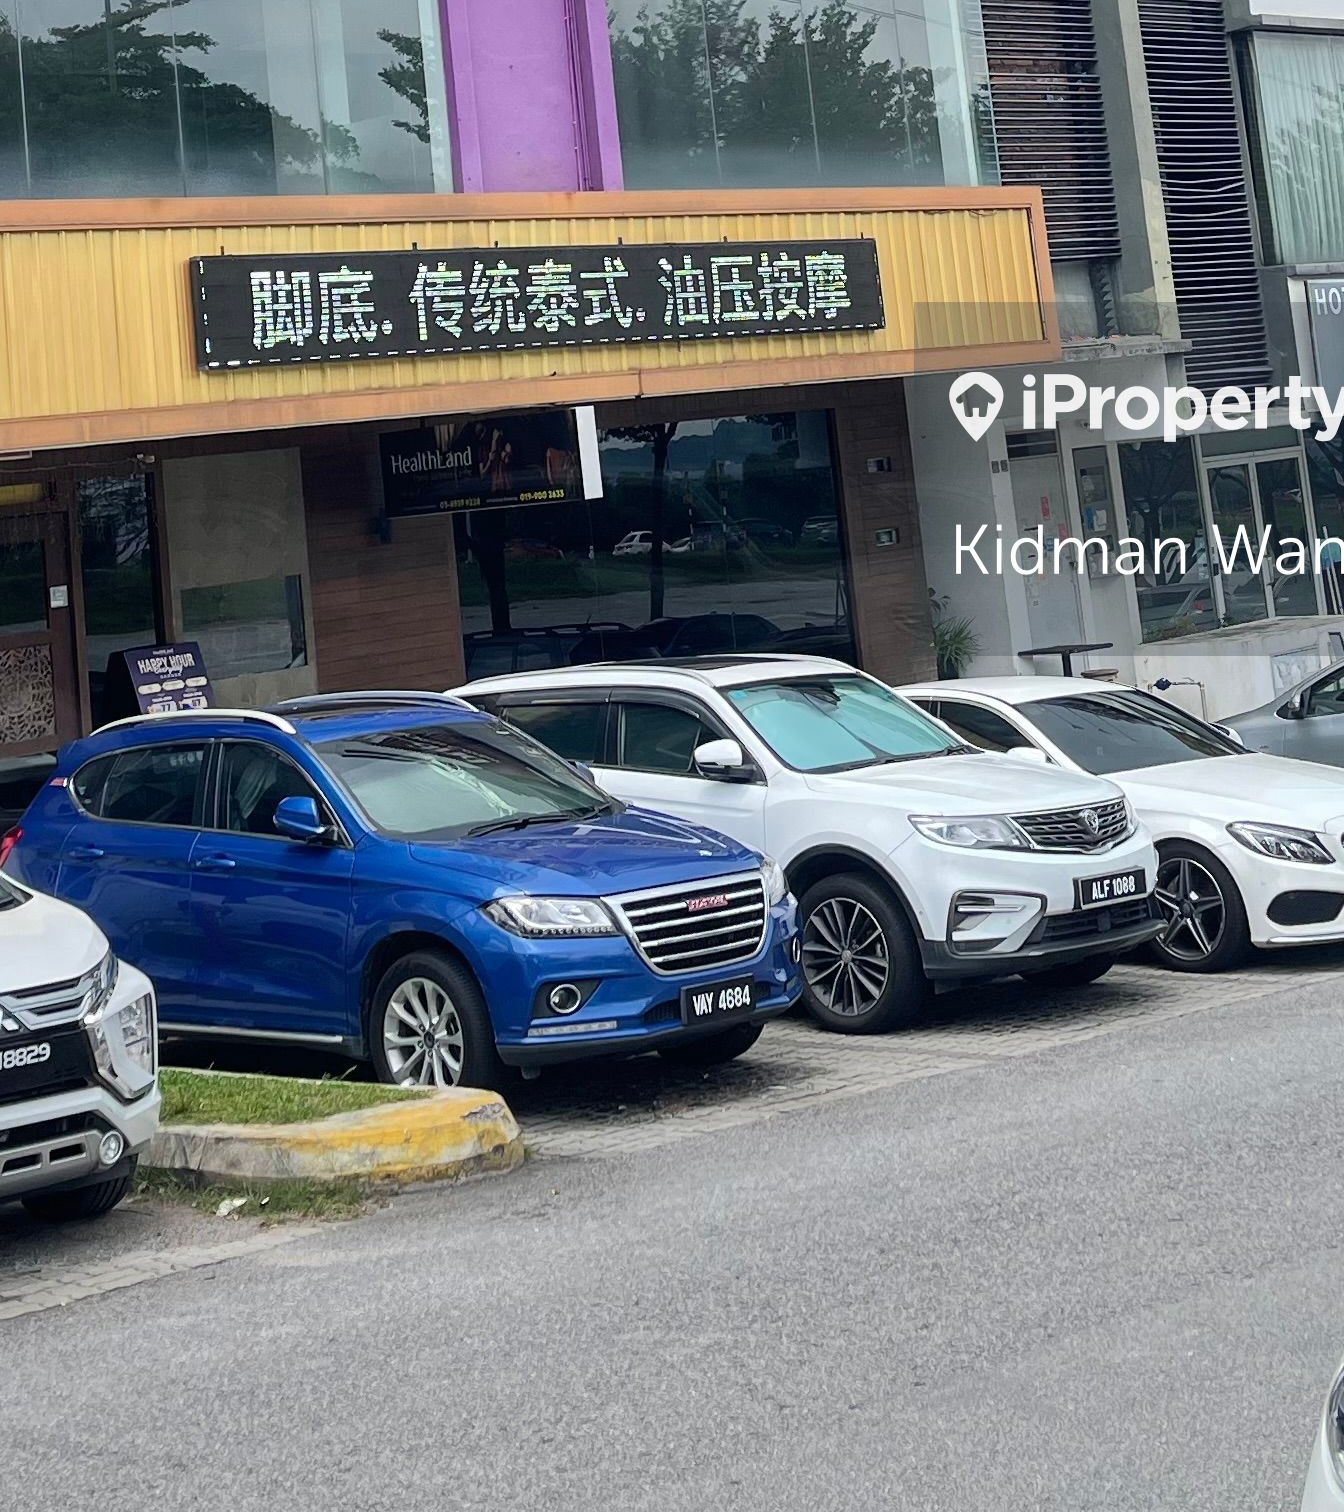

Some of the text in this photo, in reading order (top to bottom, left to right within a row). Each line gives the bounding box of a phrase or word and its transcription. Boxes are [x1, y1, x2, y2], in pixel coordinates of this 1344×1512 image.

[657, 249, 854, 326] 油压按摩
[390, 445, 473, 475] HealthLand
[137, 652, 196, 675] HAPPY HOUR
[1091, 874, 1137, 901] ALF 1088
[691, 984, 752, 1018] VAY 4684
